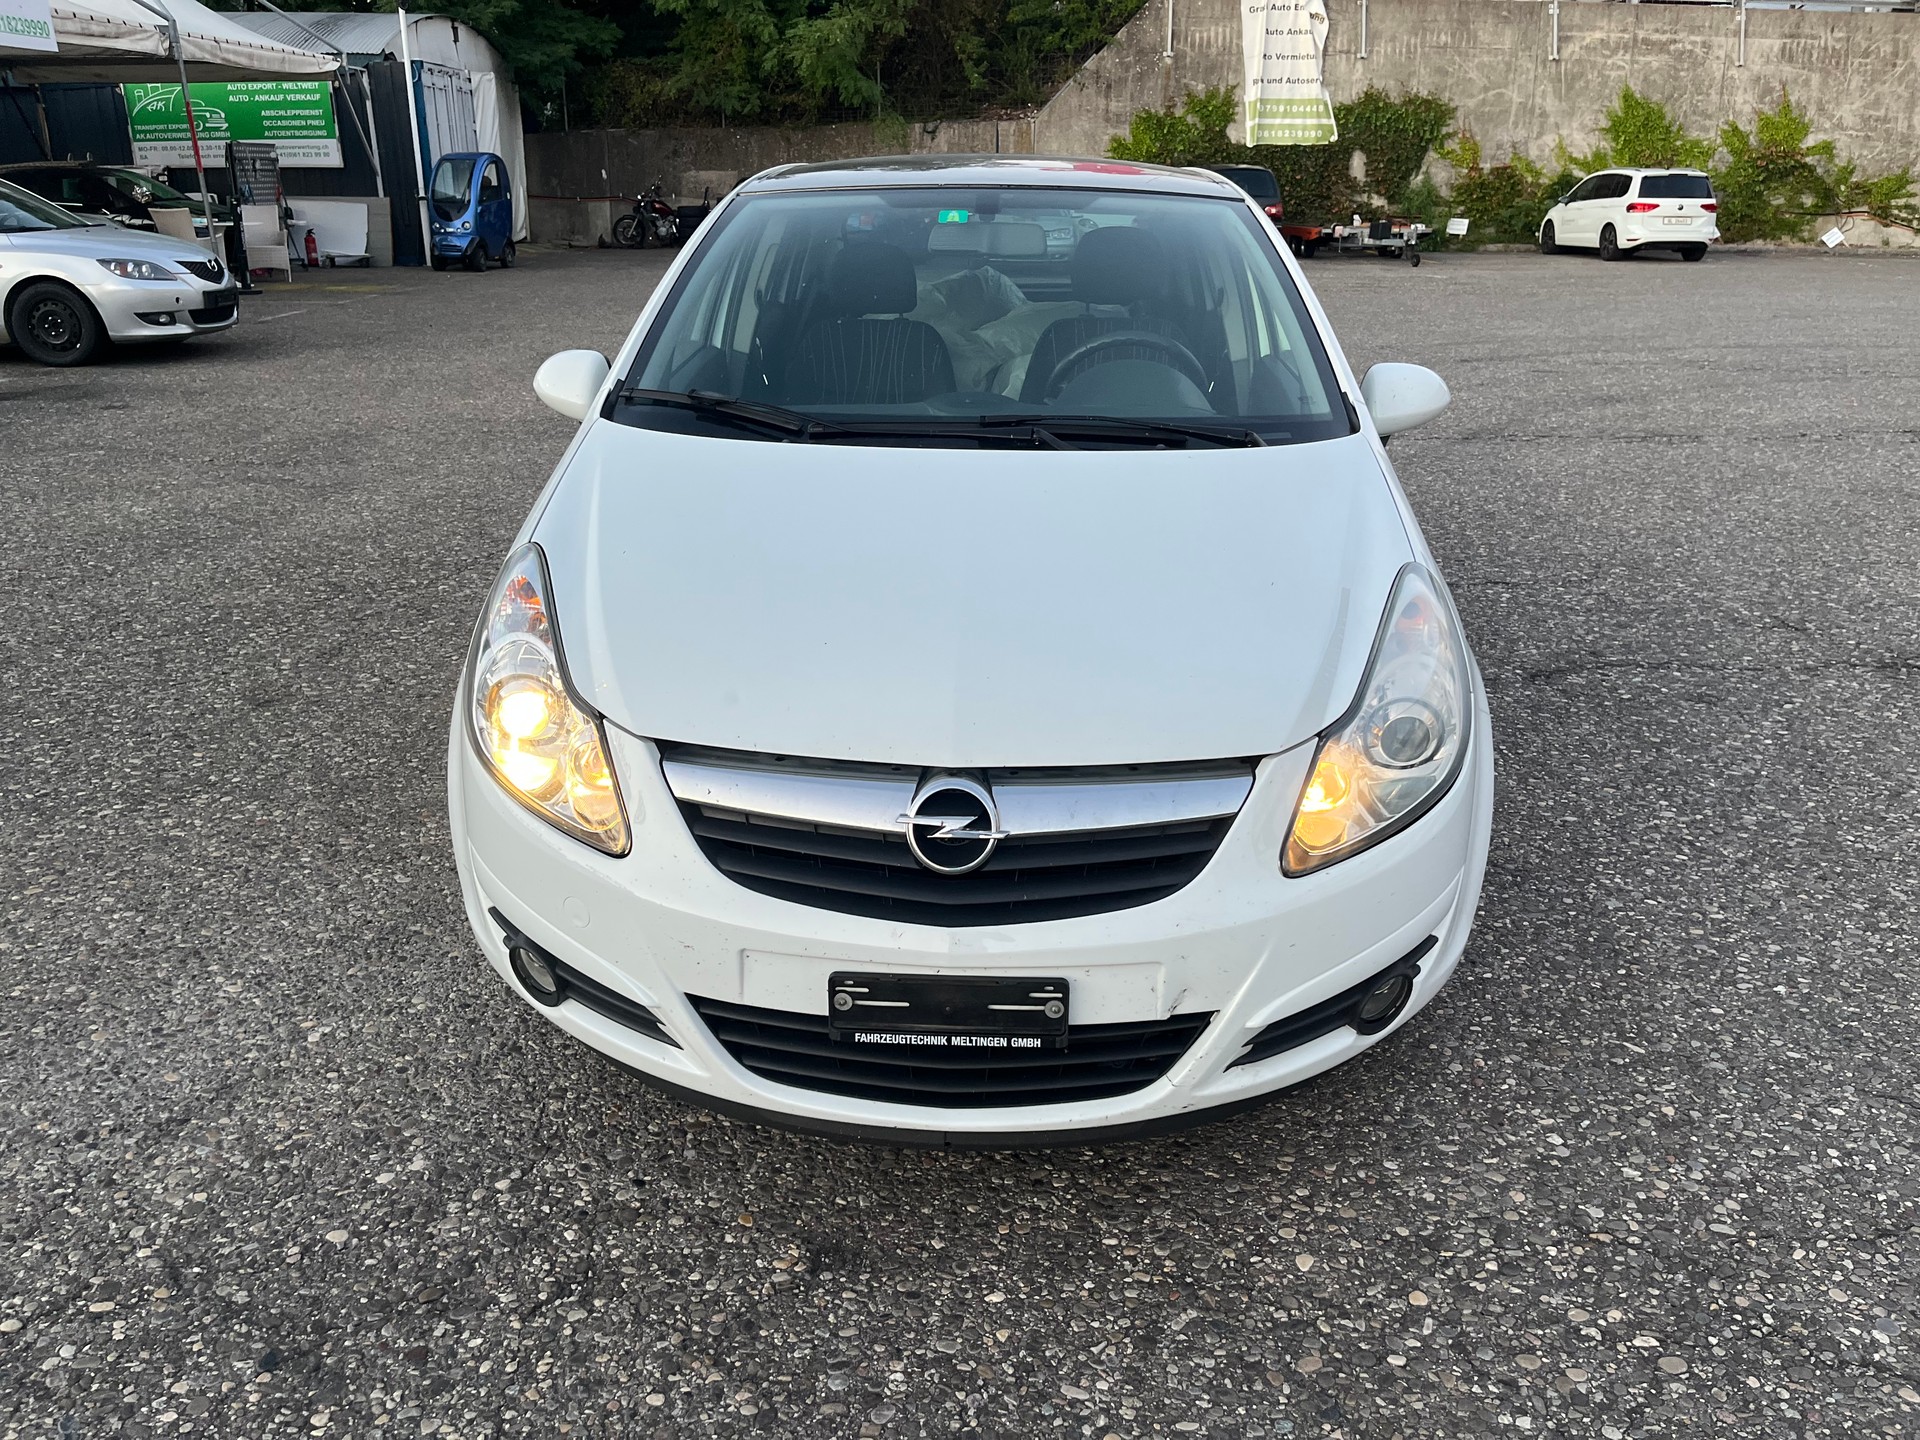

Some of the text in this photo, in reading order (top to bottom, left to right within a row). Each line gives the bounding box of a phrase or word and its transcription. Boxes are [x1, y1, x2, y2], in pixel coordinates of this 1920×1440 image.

[1270, 3, 1291, 11] Auto
[0, 15, 50, 36] 18239990
[1286, 28, 1313, 36] Ankau
[1275, 52, 1317, 61] Vermietu
[1266, 76, 1283, 84] und
[1285, 77, 1320, 85] Autoser
[227, 83, 247, 91] AUTO
[282, 82, 319, 90] WELTWEIT
[229, 94, 249, 102] AUTO
[254, 94, 285, 102] ANKAUF
[286, 93, 321, 101] VERKAUF
[261, 109, 323, 117] ABSCHLEPPDIENST
[263, 119, 325, 127] OCCASIONEN PNEU
[146, 131, 210, 139] AUTOVERWERUNG
[854, 1032, 1042, 1048] FAHRZEUGTECHNIK MELTINGEN GMBH
